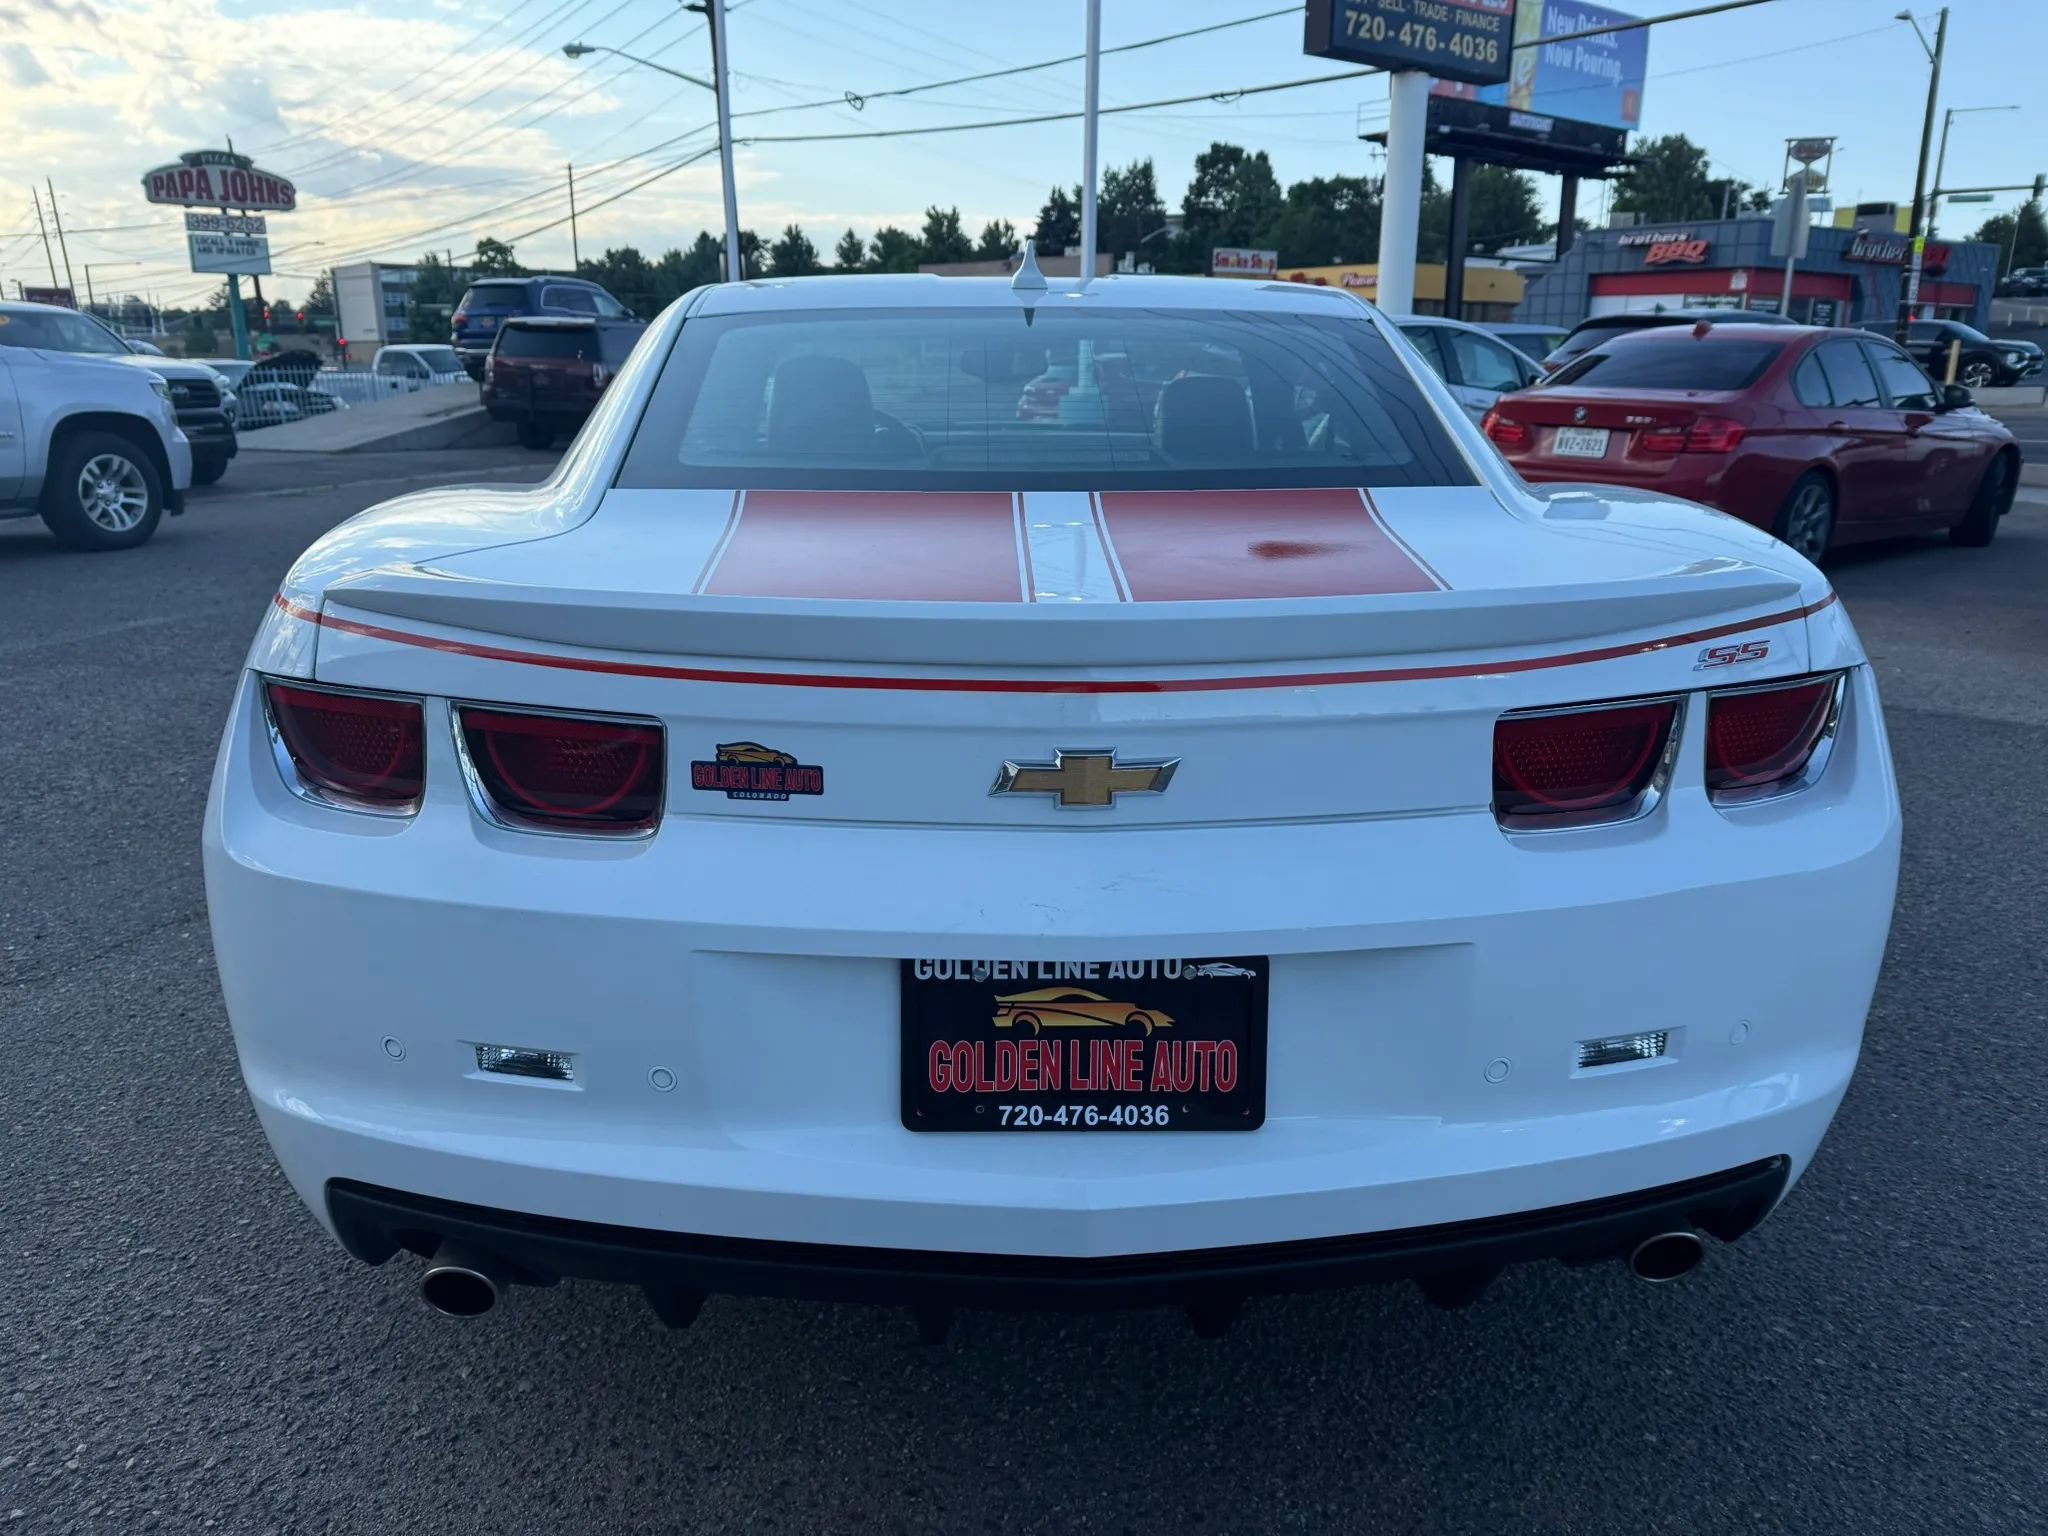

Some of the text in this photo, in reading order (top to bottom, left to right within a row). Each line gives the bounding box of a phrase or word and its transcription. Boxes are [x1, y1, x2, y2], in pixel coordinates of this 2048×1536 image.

[1414, 1, 1448, 22] TRADE
[1455, 9, 1500, 32] FINANCE
[1547, 5, 1575, 34] New
[1544, 43, 1624, 87] Now Pouring.
[152, 168, 293, 205] PAPA JOHNS
[189, 214, 265, 231] 399-6262
[1215, 252, 1275, 274] Smoke Shop
[1645, 241, 1708, 264] BBQ
[1697, 640, 1770, 670] SS
[694, 765, 820, 792] GOLDEN LINE AUTO
[732, 791, 787, 800] COLORADO
[1038, 959, 1099, 979] LINE
[929, 1039, 1238, 1092] GOLDEN LINE AUTO
[998, 1104, 1170, 1126] 720-476-4036
